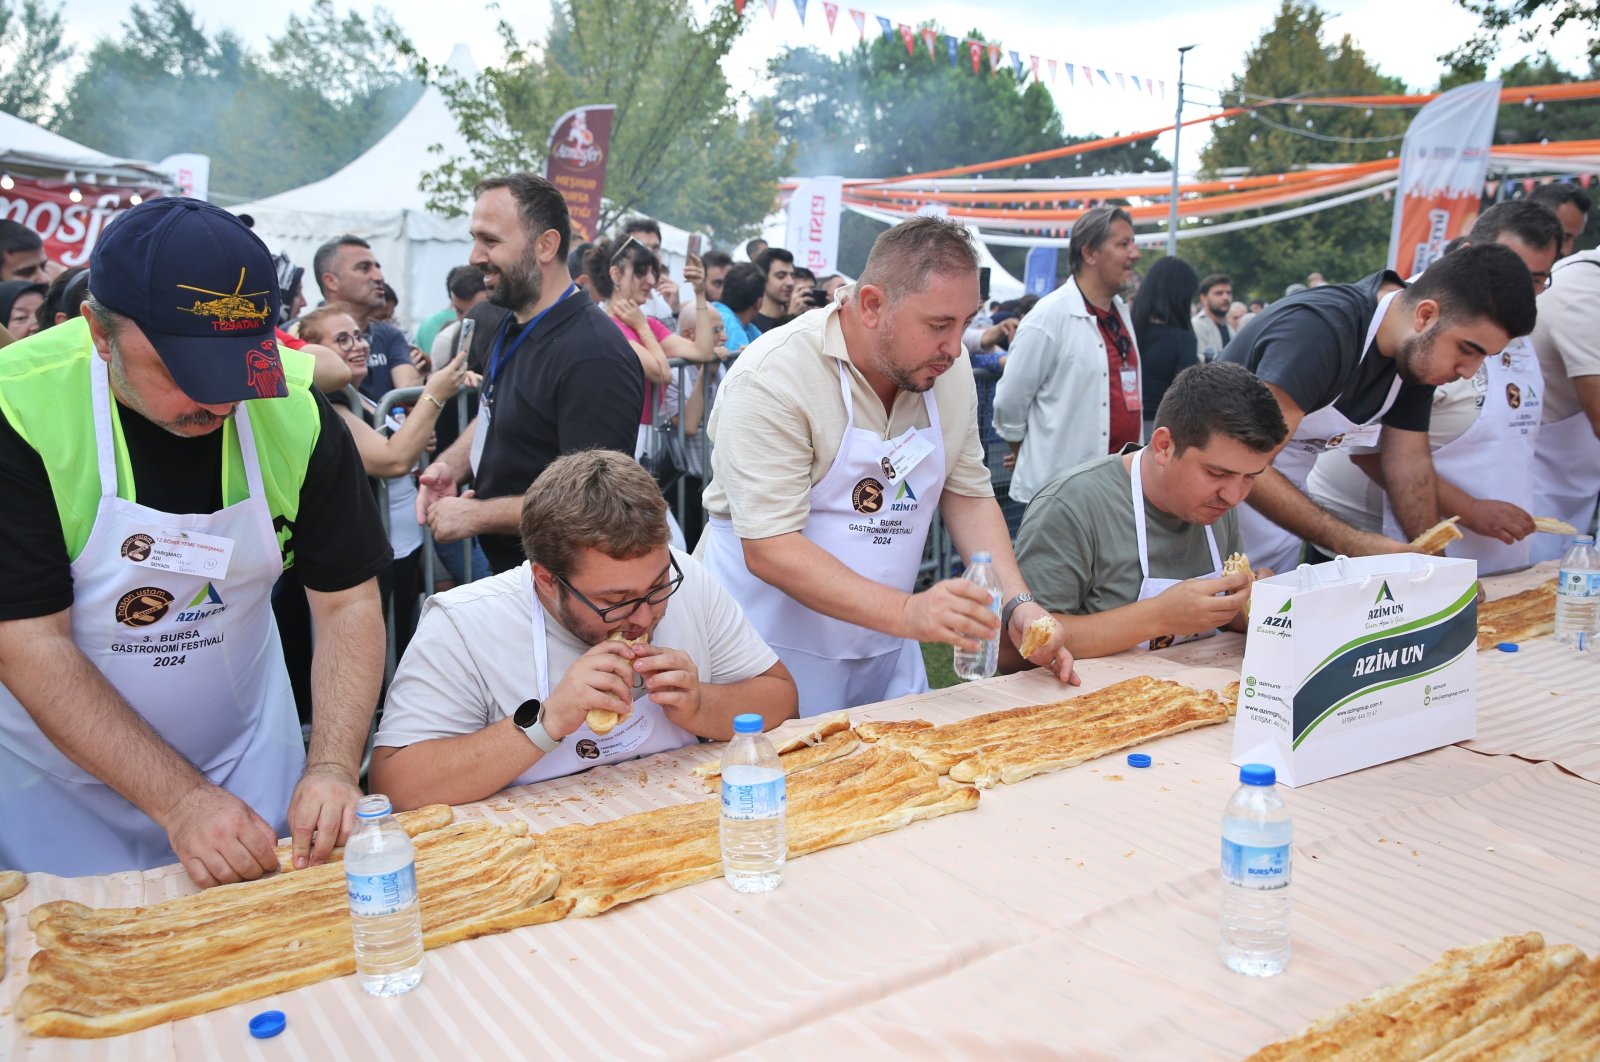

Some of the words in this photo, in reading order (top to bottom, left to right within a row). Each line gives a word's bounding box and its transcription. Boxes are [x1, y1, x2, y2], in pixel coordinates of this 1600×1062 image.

[849, 523, 889, 534] GASTRONOMİ
[873, 536, 892, 545] 2024
[117, 593, 135, 616] hasan
[136, 587, 166, 597] ustam
[176, 608, 210, 622] AZİM
[1368, 605, 1391, 620] AZİM
[1392, 603, 1404, 615] UN
[111, 641, 179, 654] GASTRONOMİ
[181, 632, 225, 651] FESTİVALİ
[143, 635, 153, 643] 3.
[160, 629, 201, 643] BURSA
[153, 654, 187, 667] 2024
[1352, 647, 1399, 677] AZİM
[1401, 643, 1425, 665] UN
